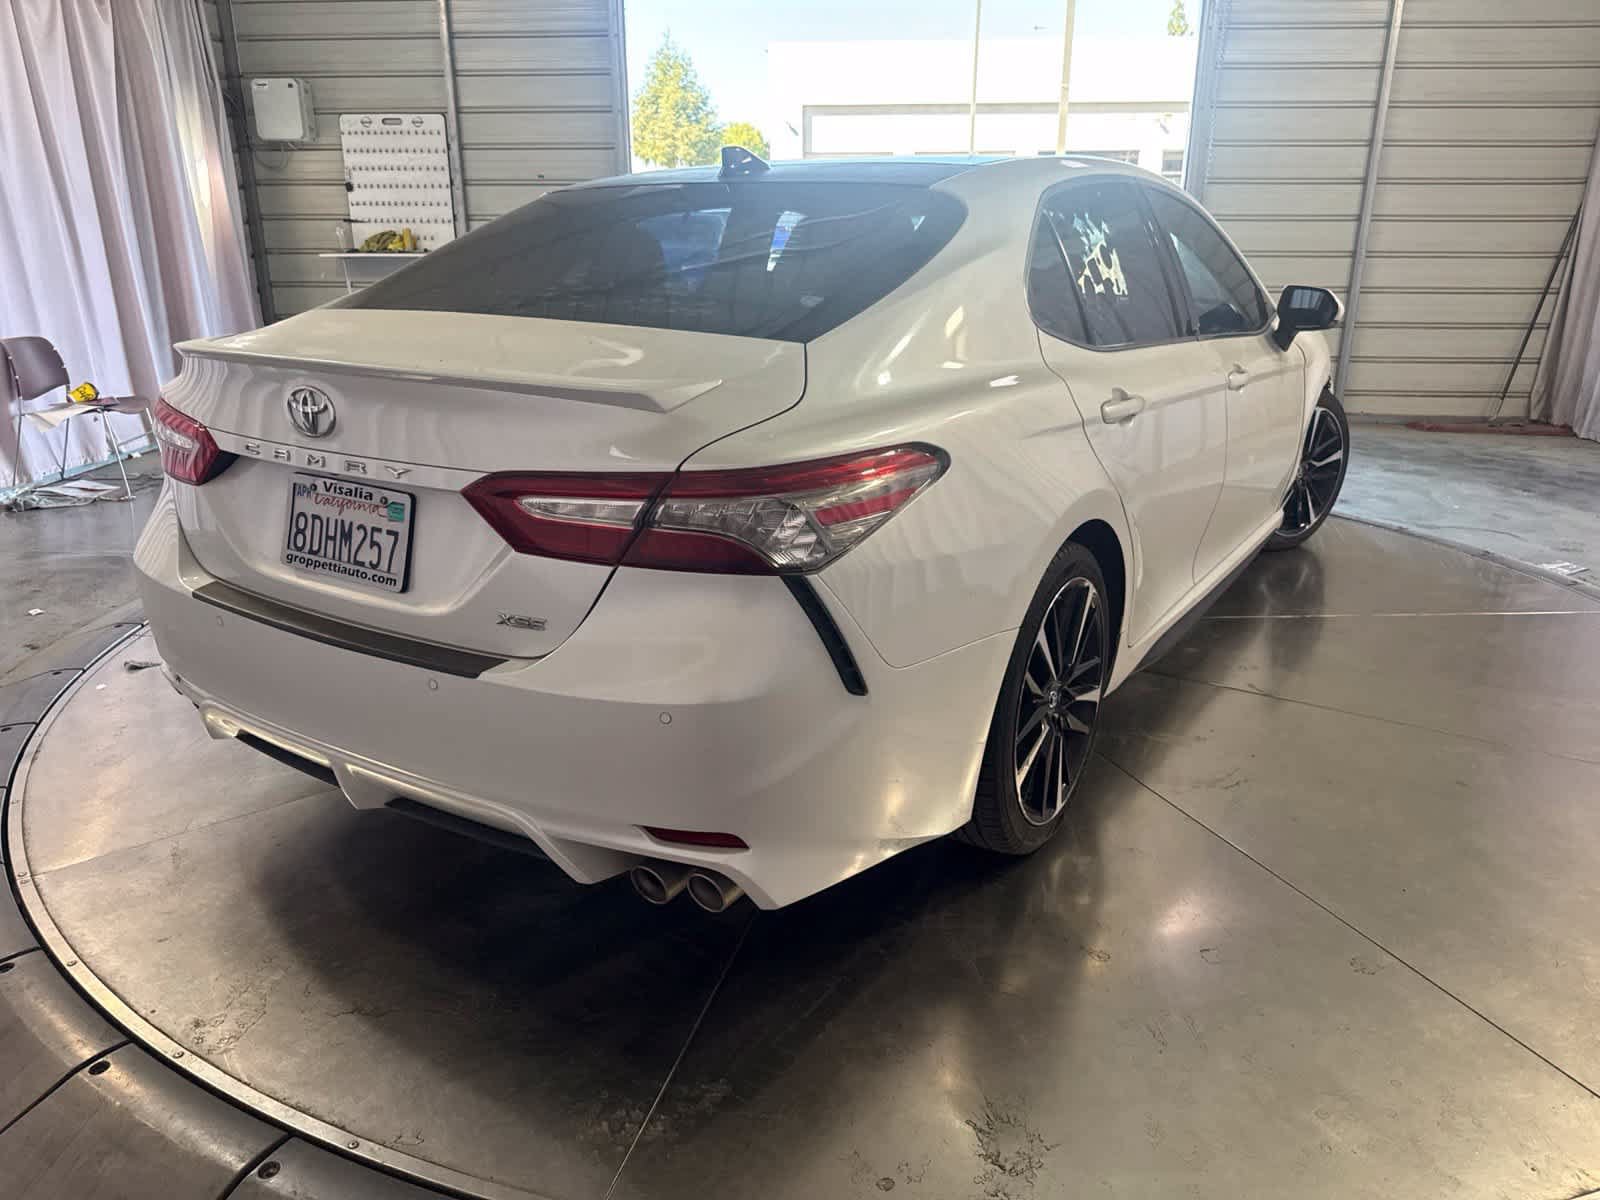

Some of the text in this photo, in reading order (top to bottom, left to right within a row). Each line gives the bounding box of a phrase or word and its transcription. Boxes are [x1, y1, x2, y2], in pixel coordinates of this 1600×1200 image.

[245, 442, 412, 479] CAMRY
[323, 481, 373, 501] Visalia
[293, 512, 399, 573] 8DHM257
[286, 553, 397, 586] groppettiauto.com
[496, 614, 547, 631] XSE
